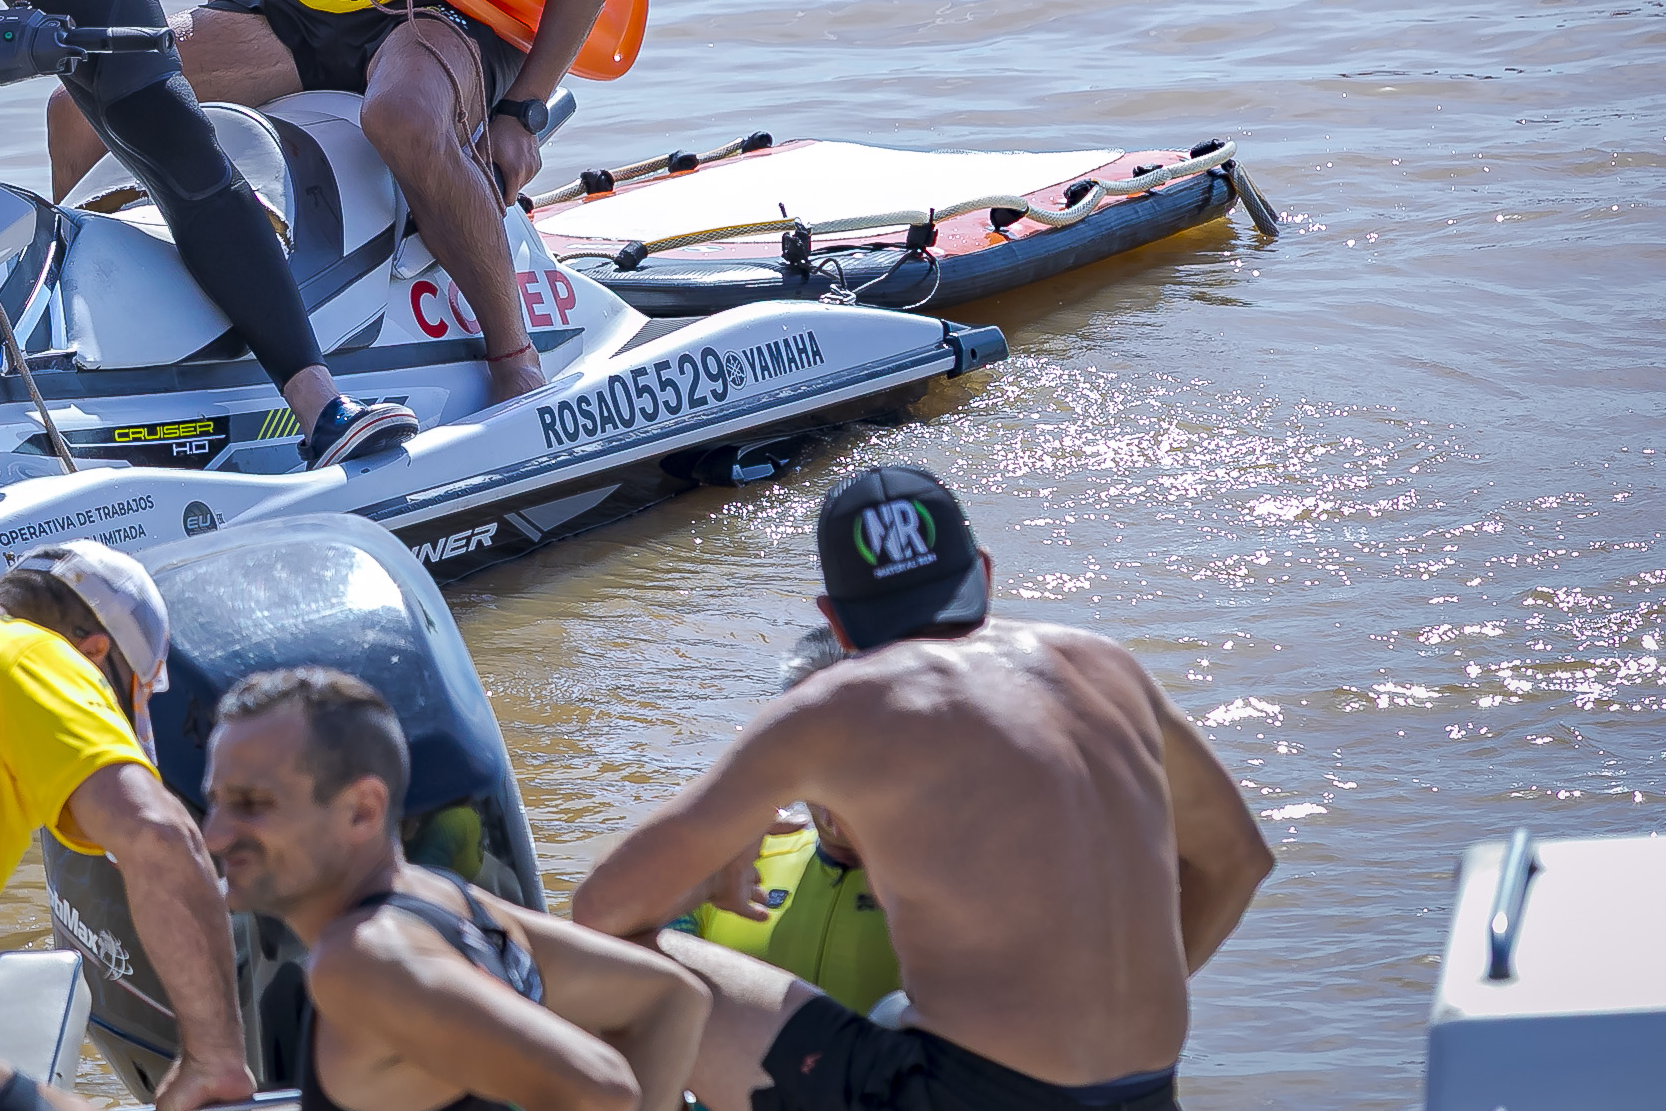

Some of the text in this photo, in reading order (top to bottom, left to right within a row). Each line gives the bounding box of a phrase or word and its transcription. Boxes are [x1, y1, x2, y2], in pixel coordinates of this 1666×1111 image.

[410, 270, 577, 339] CEP
[741, 330, 825, 383] YAMAHA
[114, 421, 214, 442] CRUISER
[76, 509, 96, 528] DE
[95, 494, 155, 522] TRABAJOS
[186, 513, 212, 530] EU
